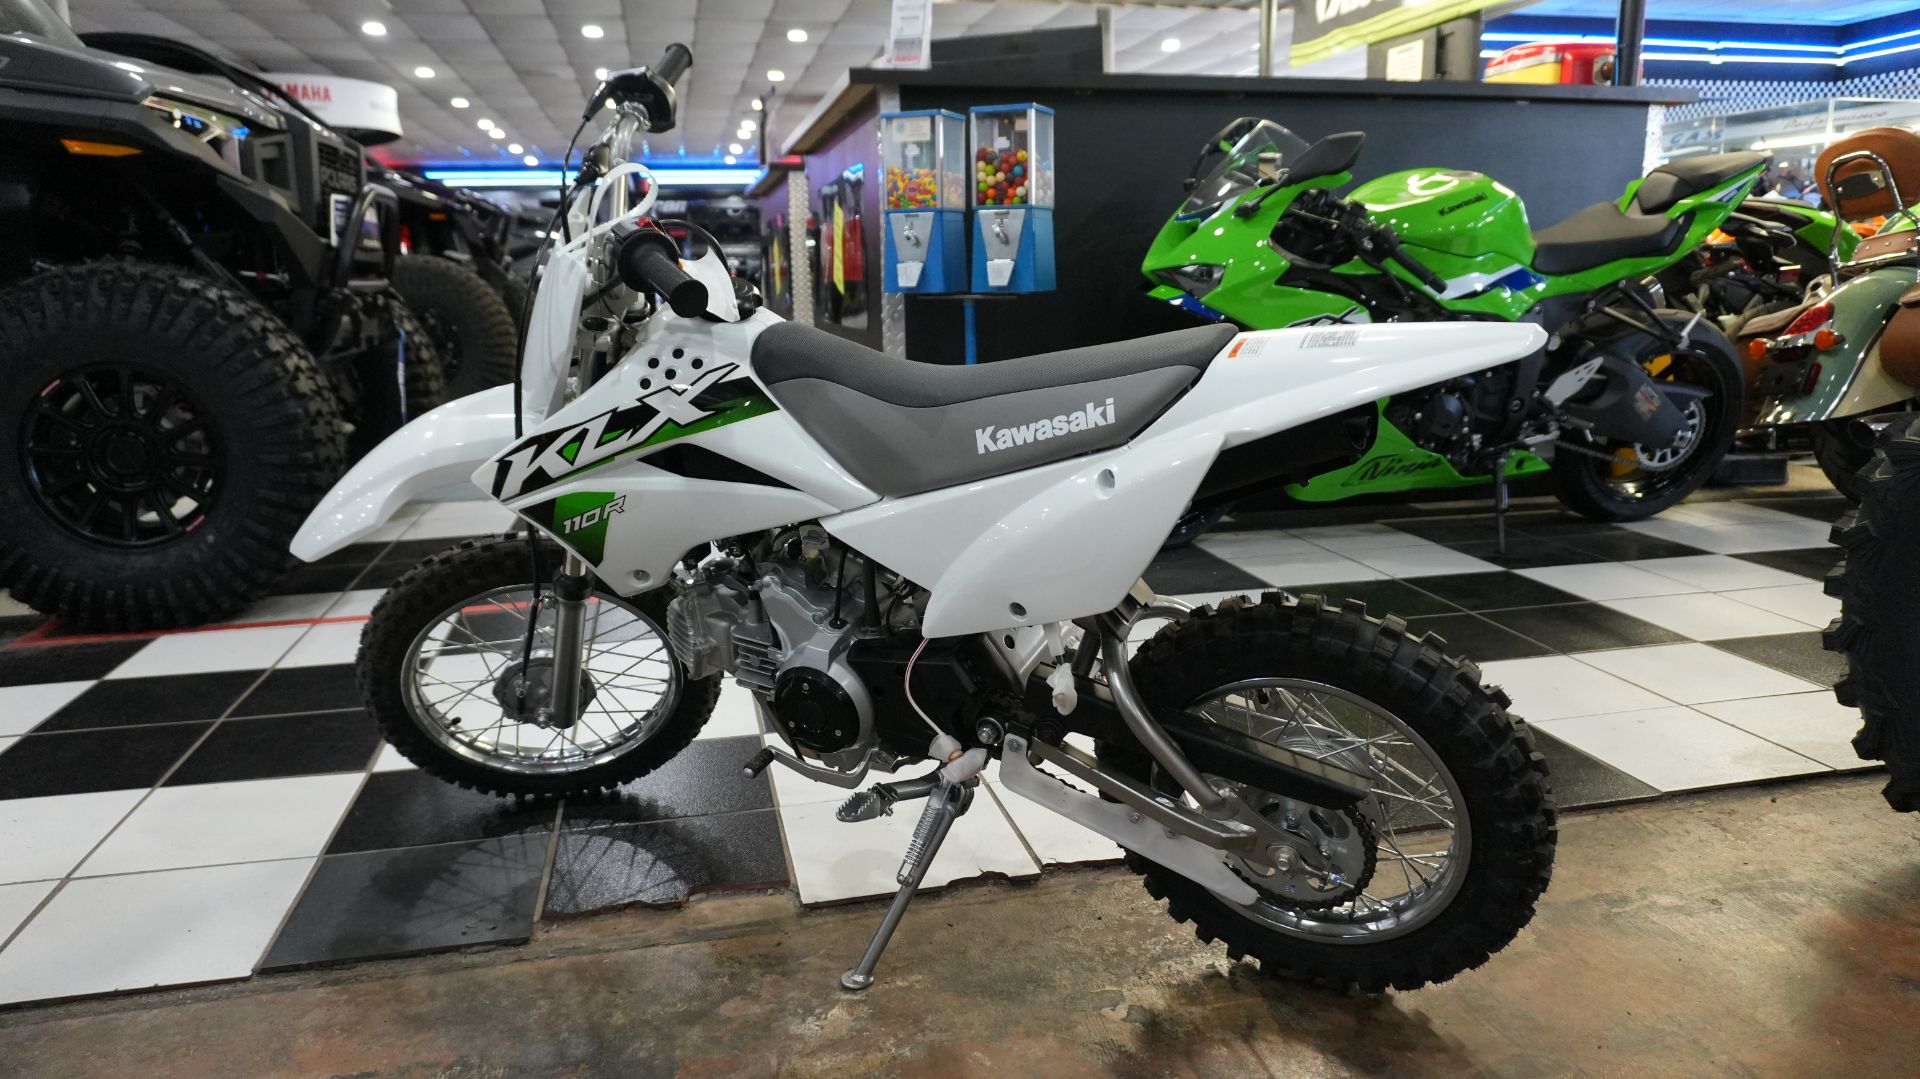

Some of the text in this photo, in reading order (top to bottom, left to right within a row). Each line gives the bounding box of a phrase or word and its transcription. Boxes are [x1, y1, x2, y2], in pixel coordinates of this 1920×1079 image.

[1438, 191, 1488, 216] Kawasaki
[496, 362, 741, 502] KLX
[975, 397, 1116, 455] Kawasaki
[1348, 454, 1442, 483] Ninja
